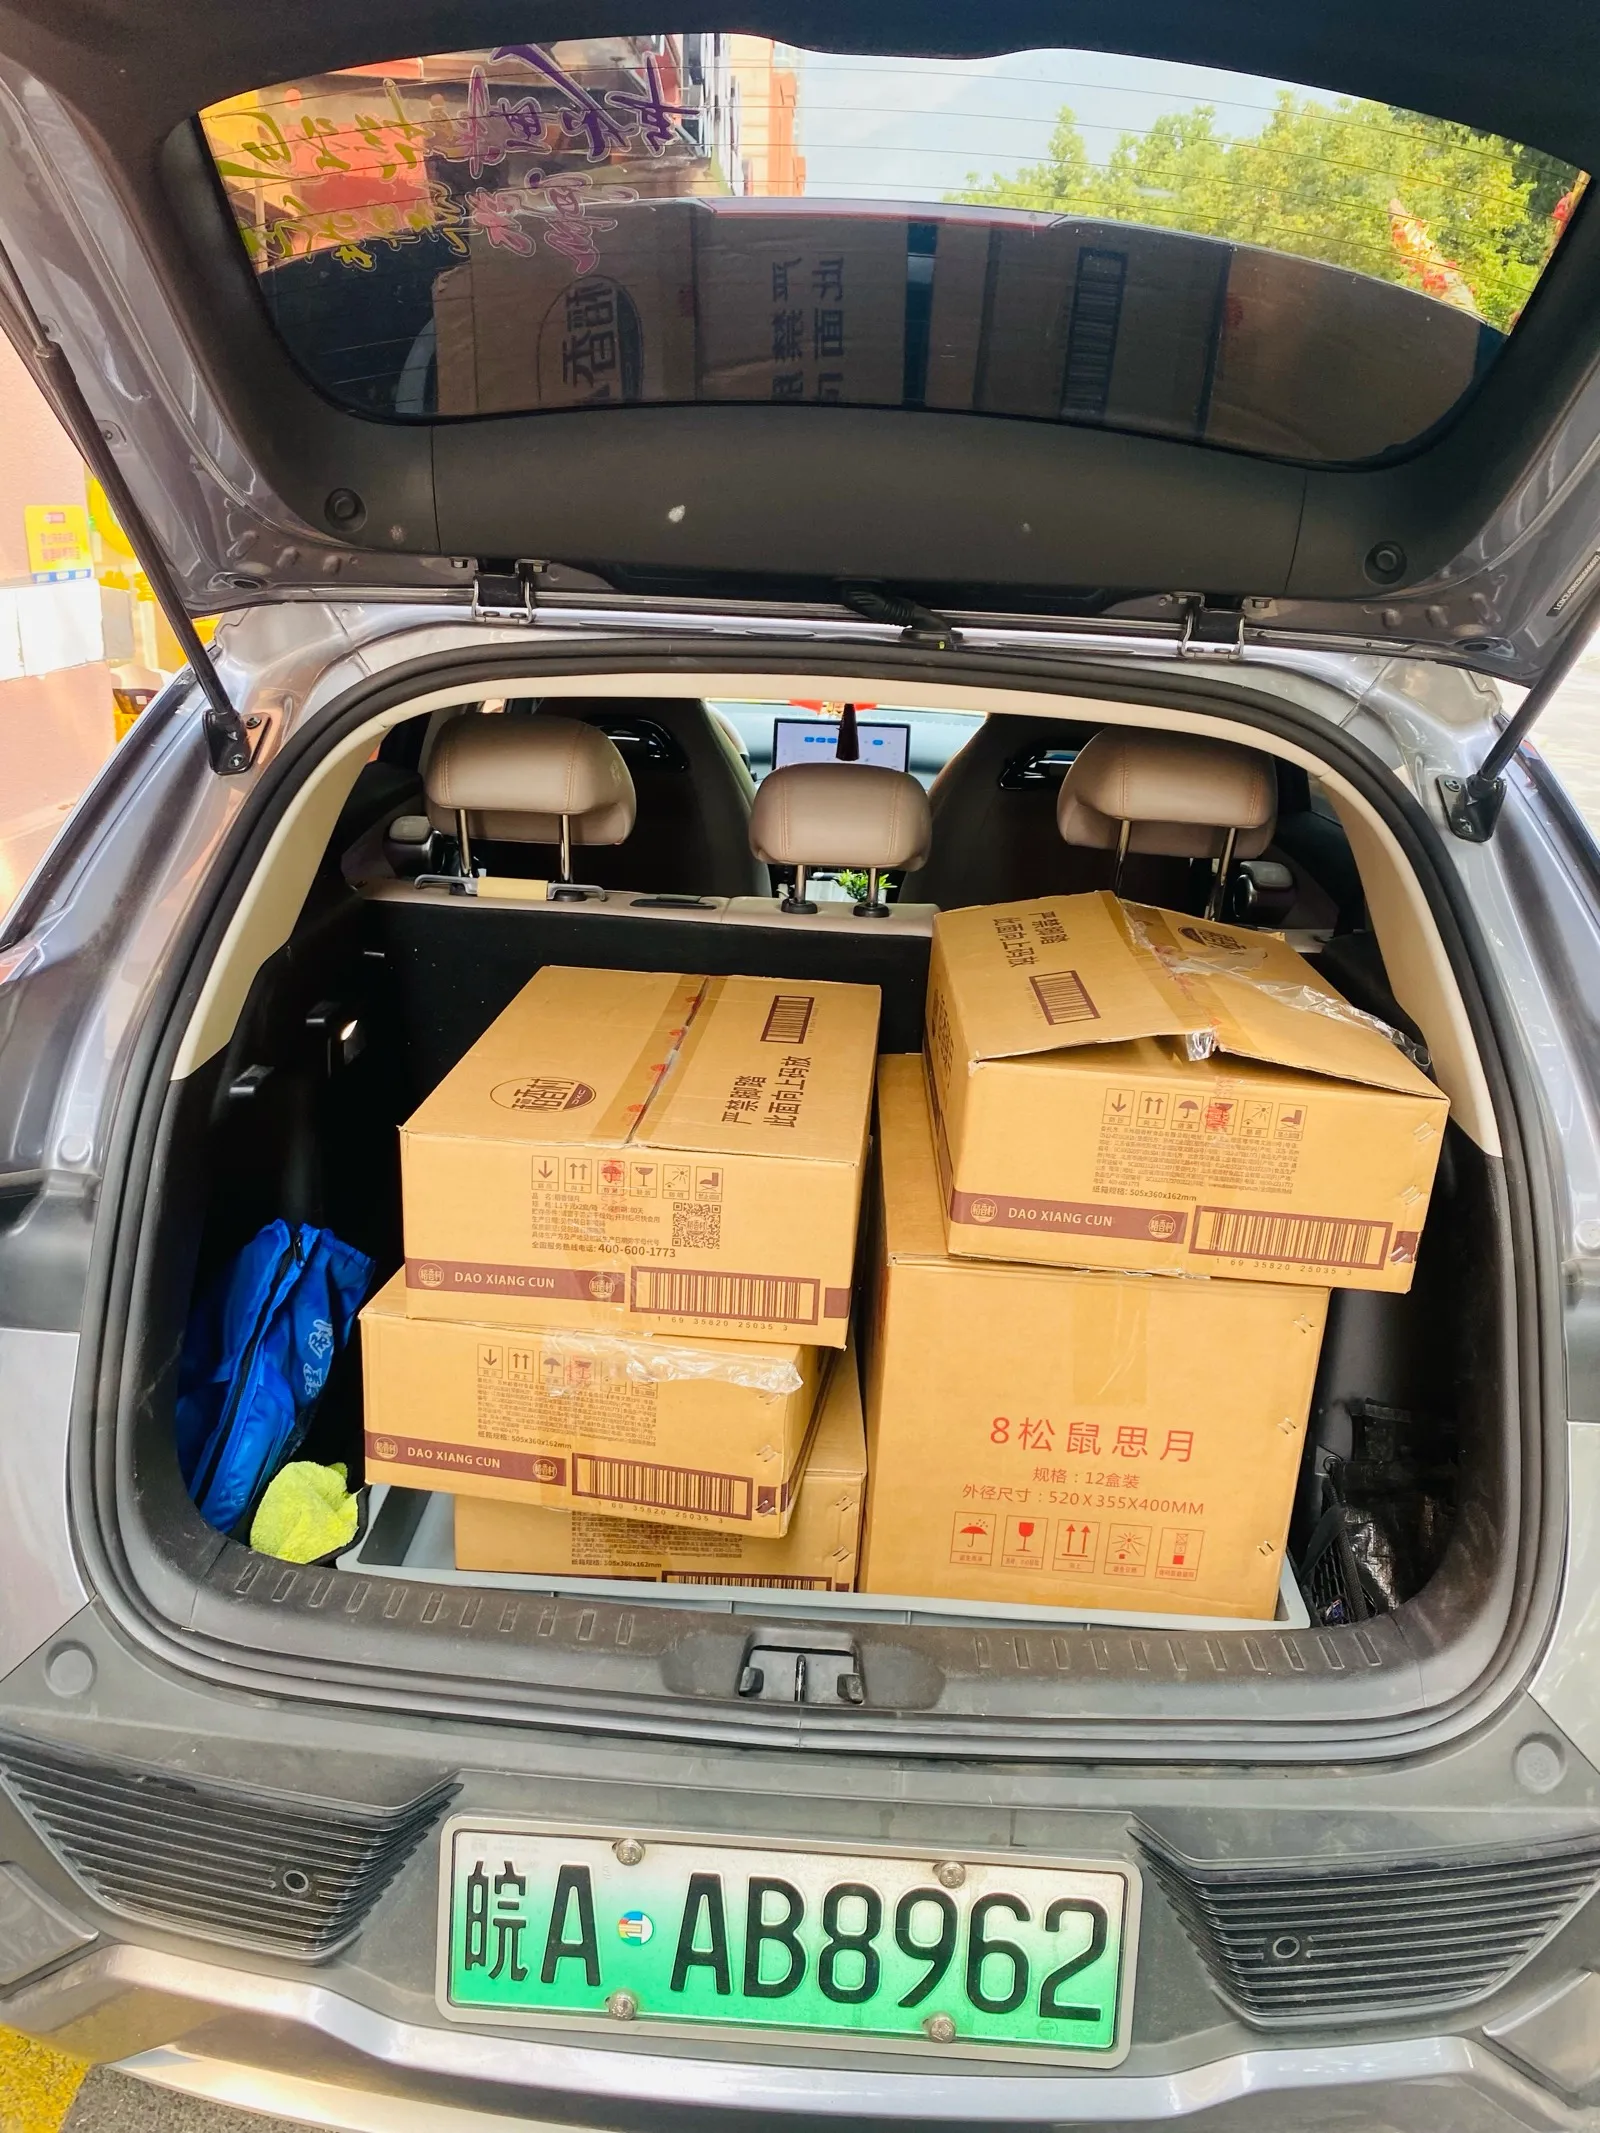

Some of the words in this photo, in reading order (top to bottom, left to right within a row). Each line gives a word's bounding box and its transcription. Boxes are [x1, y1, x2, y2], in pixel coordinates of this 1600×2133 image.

[511, 1078, 575, 1111] 稻香村
[763, 1055, 812, 1128] 此面向上码放
[1008, 1207, 1037, 1220] DAO
[1040, 1210, 1081, 1224] XIANG
[1085, 1214, 1112, 1227] CUN
[598, 1244, 676, 1258] 400-600-1773
[1254, 1260, 1290, 1271] 35820
[1300, 1265, 1336, 1275] 25035
[454, 1271, 482, 1284] DAO
[486, 1274, 525, 1287] XIANG
[528, 1276, 555, 1289] CUN
[693, 1318, 729, 1327] 35820
[738, 1321, 773, 1330] 25035
[990, 1416, 1195, 1463] 8松鼠思月
[408, 1447, 432, 1459] DAO
[436, 1451, 473, 1465] XIANG
[476, 1456, 500, 1468] CUN
